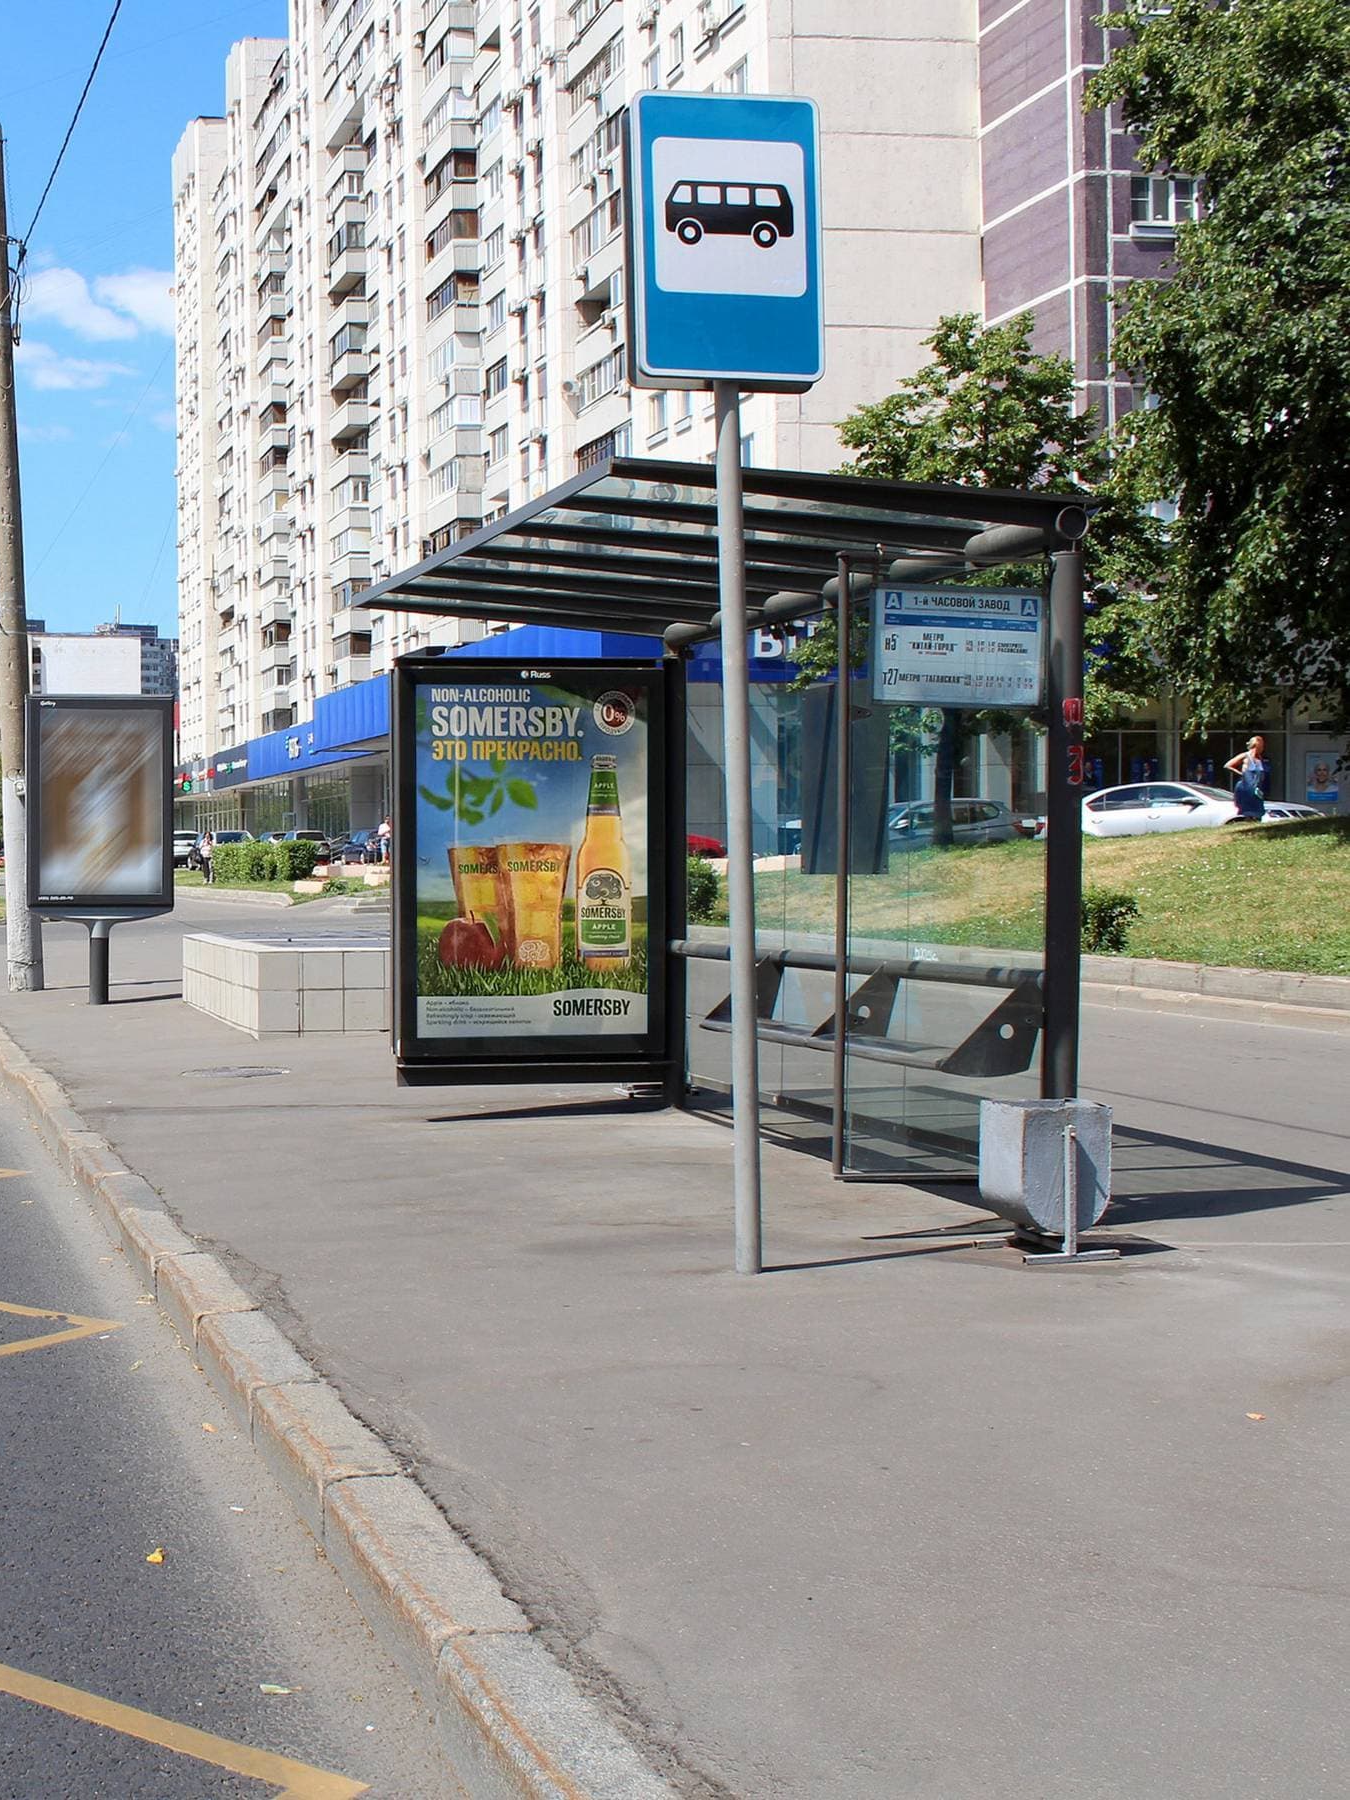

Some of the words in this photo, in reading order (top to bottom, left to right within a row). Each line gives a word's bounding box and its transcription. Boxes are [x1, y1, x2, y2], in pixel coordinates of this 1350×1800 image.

[931, 596, 976, 608] ЧАСОВОЙ
[978, 599, 1011, 611] ЗАВОД
[431, 688, 530, 702] NON-ALCOHOLIC
[431, 705, 585, 737] SOMERSBY.
[432, 739, 466, 761] ЭТО
[471, 739, 583, 761] ПРЕКРАСНО.
[458, 863, 498, 874] SOMERS
[580, 907, 626, 918] SOMERSBY
[592, 922, 616, 930] APPLE
[552, 998, 631, 1017] SOMERSBY
